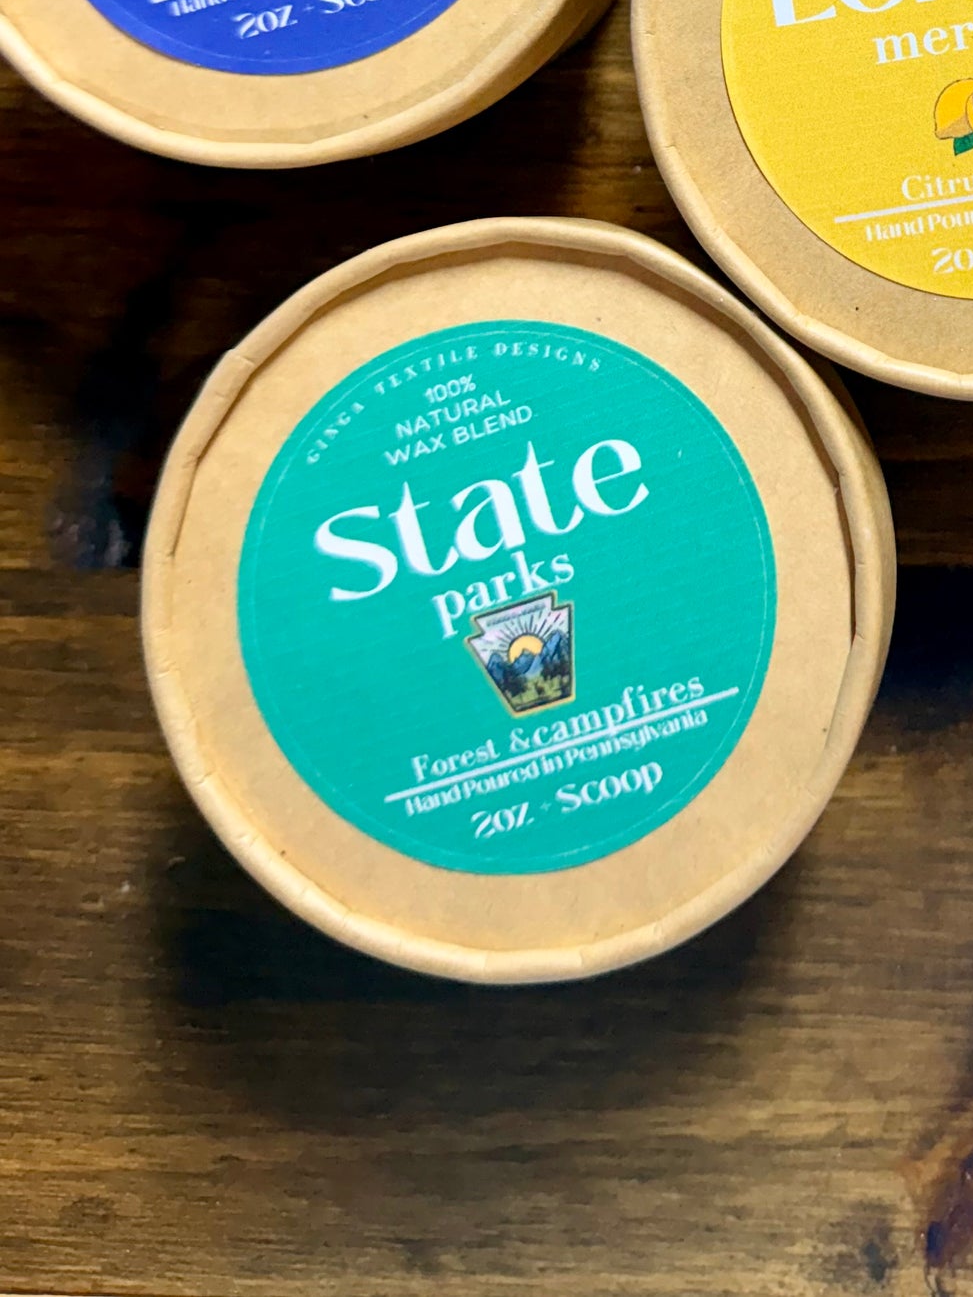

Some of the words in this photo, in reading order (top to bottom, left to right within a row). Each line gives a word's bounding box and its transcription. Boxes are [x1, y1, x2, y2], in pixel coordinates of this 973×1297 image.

[232, 5, 298, 39] 2oz
[866, 216, 923, 242] Hand
[373, 345, 477, 395] TEXTILE
[494, 341, 602, 372] DESIGNS
[424, 373, 477, 404] 100%
[384, 433, 448, 467] WAX
[452, 405, 533, 445] BLEND
[394, 390, 512, 439] NATURAL
[314, 438, 650, 602] State
[432, 550, 575, 639] parks
[405, 783, 462, 817] Hand
[462, 763, 540, 799] Poured
[566, 707, 709, 765] Pennsylvania
[411, 739, 501, 783] Forest
[470, 802, 535, 839] 2oz
[555, 760, 664, 814] Scoop
